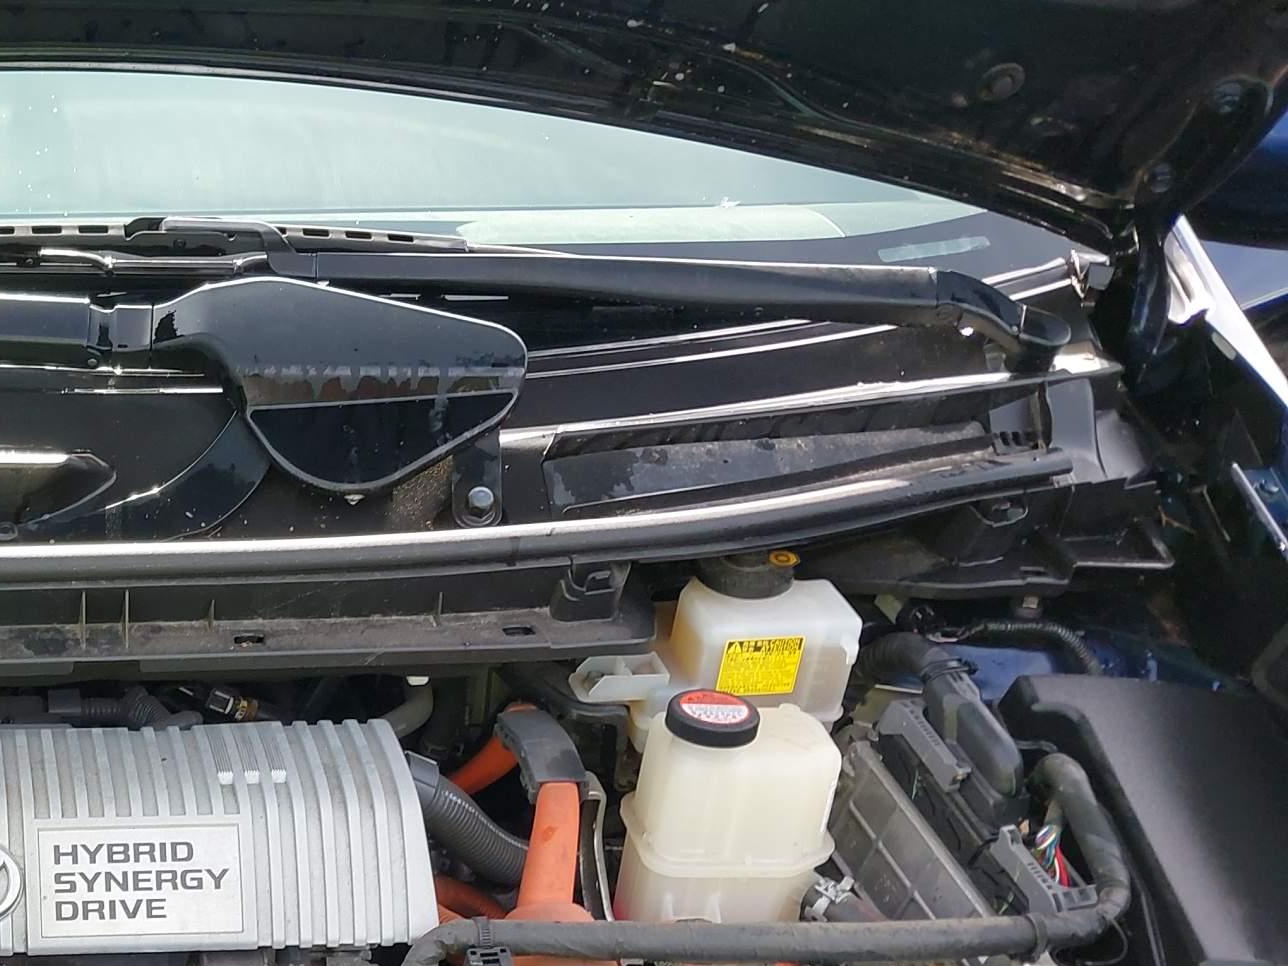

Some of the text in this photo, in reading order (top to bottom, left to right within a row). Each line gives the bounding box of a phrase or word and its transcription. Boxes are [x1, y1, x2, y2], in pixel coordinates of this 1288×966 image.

[53, 842, 194, 865] HYBRID
[54, 868, 230, 893] SYNERGY
[55, 898, 167, 921] DRIVE
